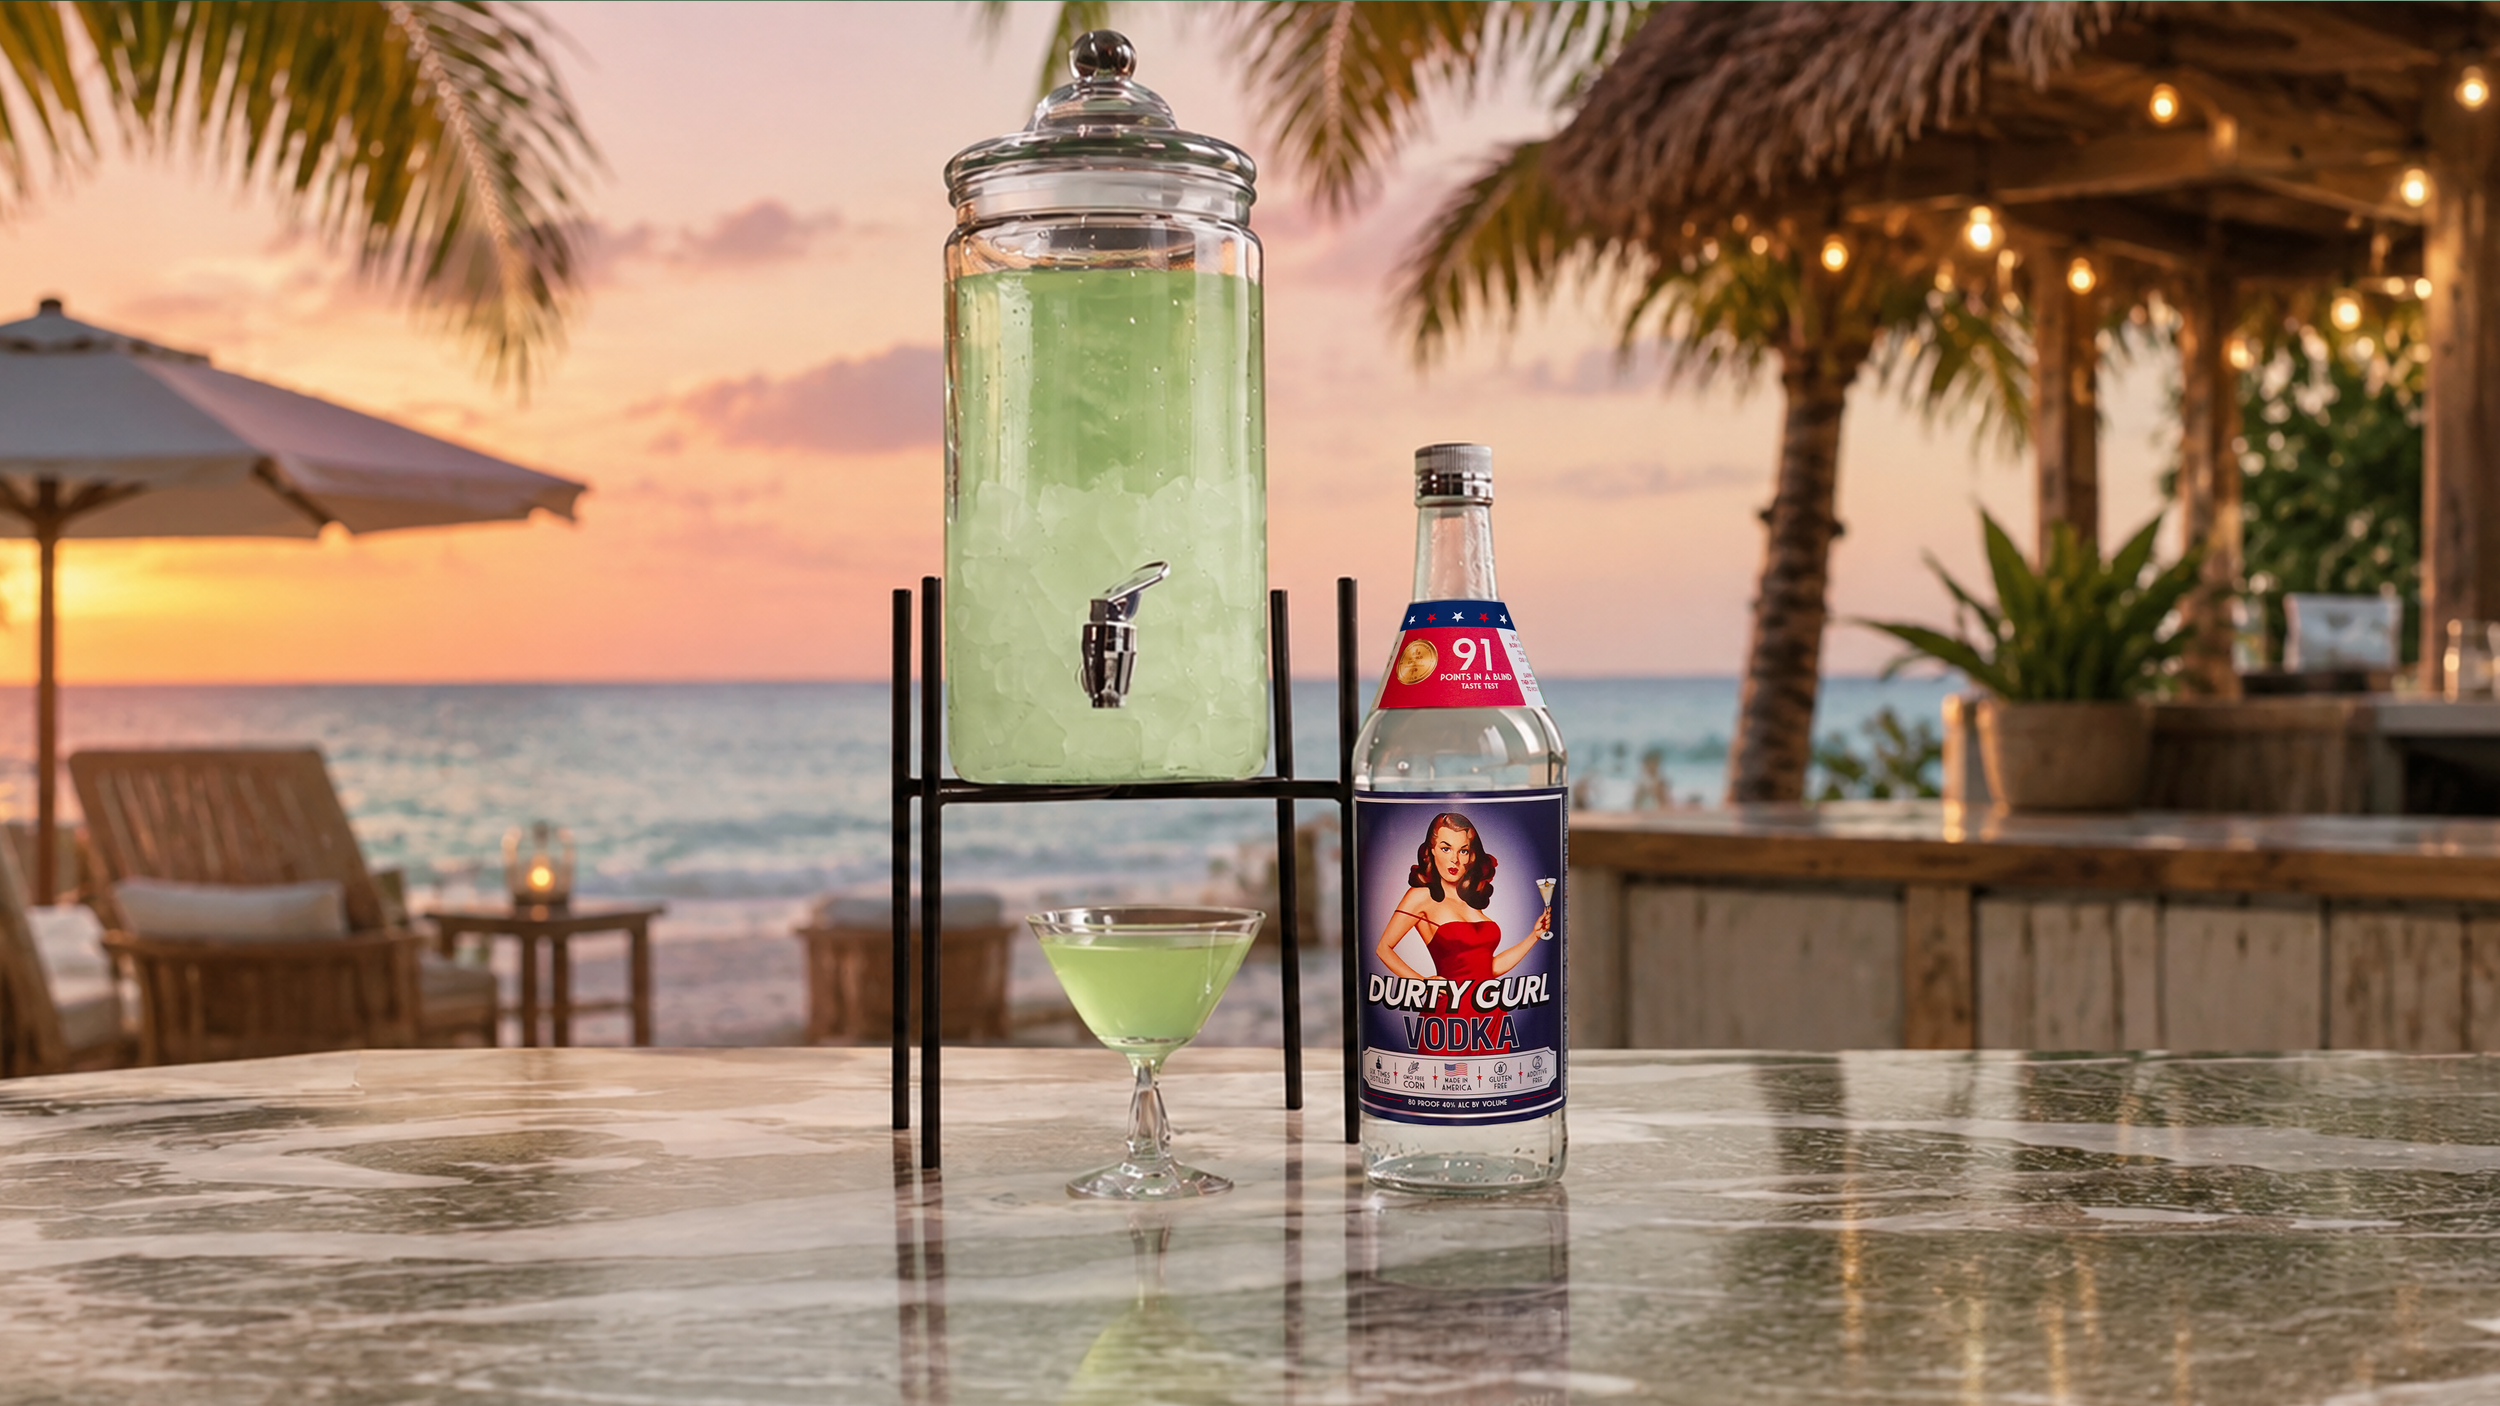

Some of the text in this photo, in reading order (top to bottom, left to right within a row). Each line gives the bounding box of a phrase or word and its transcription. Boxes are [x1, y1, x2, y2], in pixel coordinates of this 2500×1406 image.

[1452, 637, 1493, 671] 91
[1440, 673, 1471, 681] POINTS
[1368, 973, 1550, 1013] DURTY GURL
[1403, 1015, 1520, 1051] VODKA
[1377, 1070, 1390, 1078] TIMES
[1527, 1068, 1547, 1078] ADDITIVE
[1370, 1074, 1390, 1084] DISTILLED
[1404, 1080, 1425, 1089] CORN
